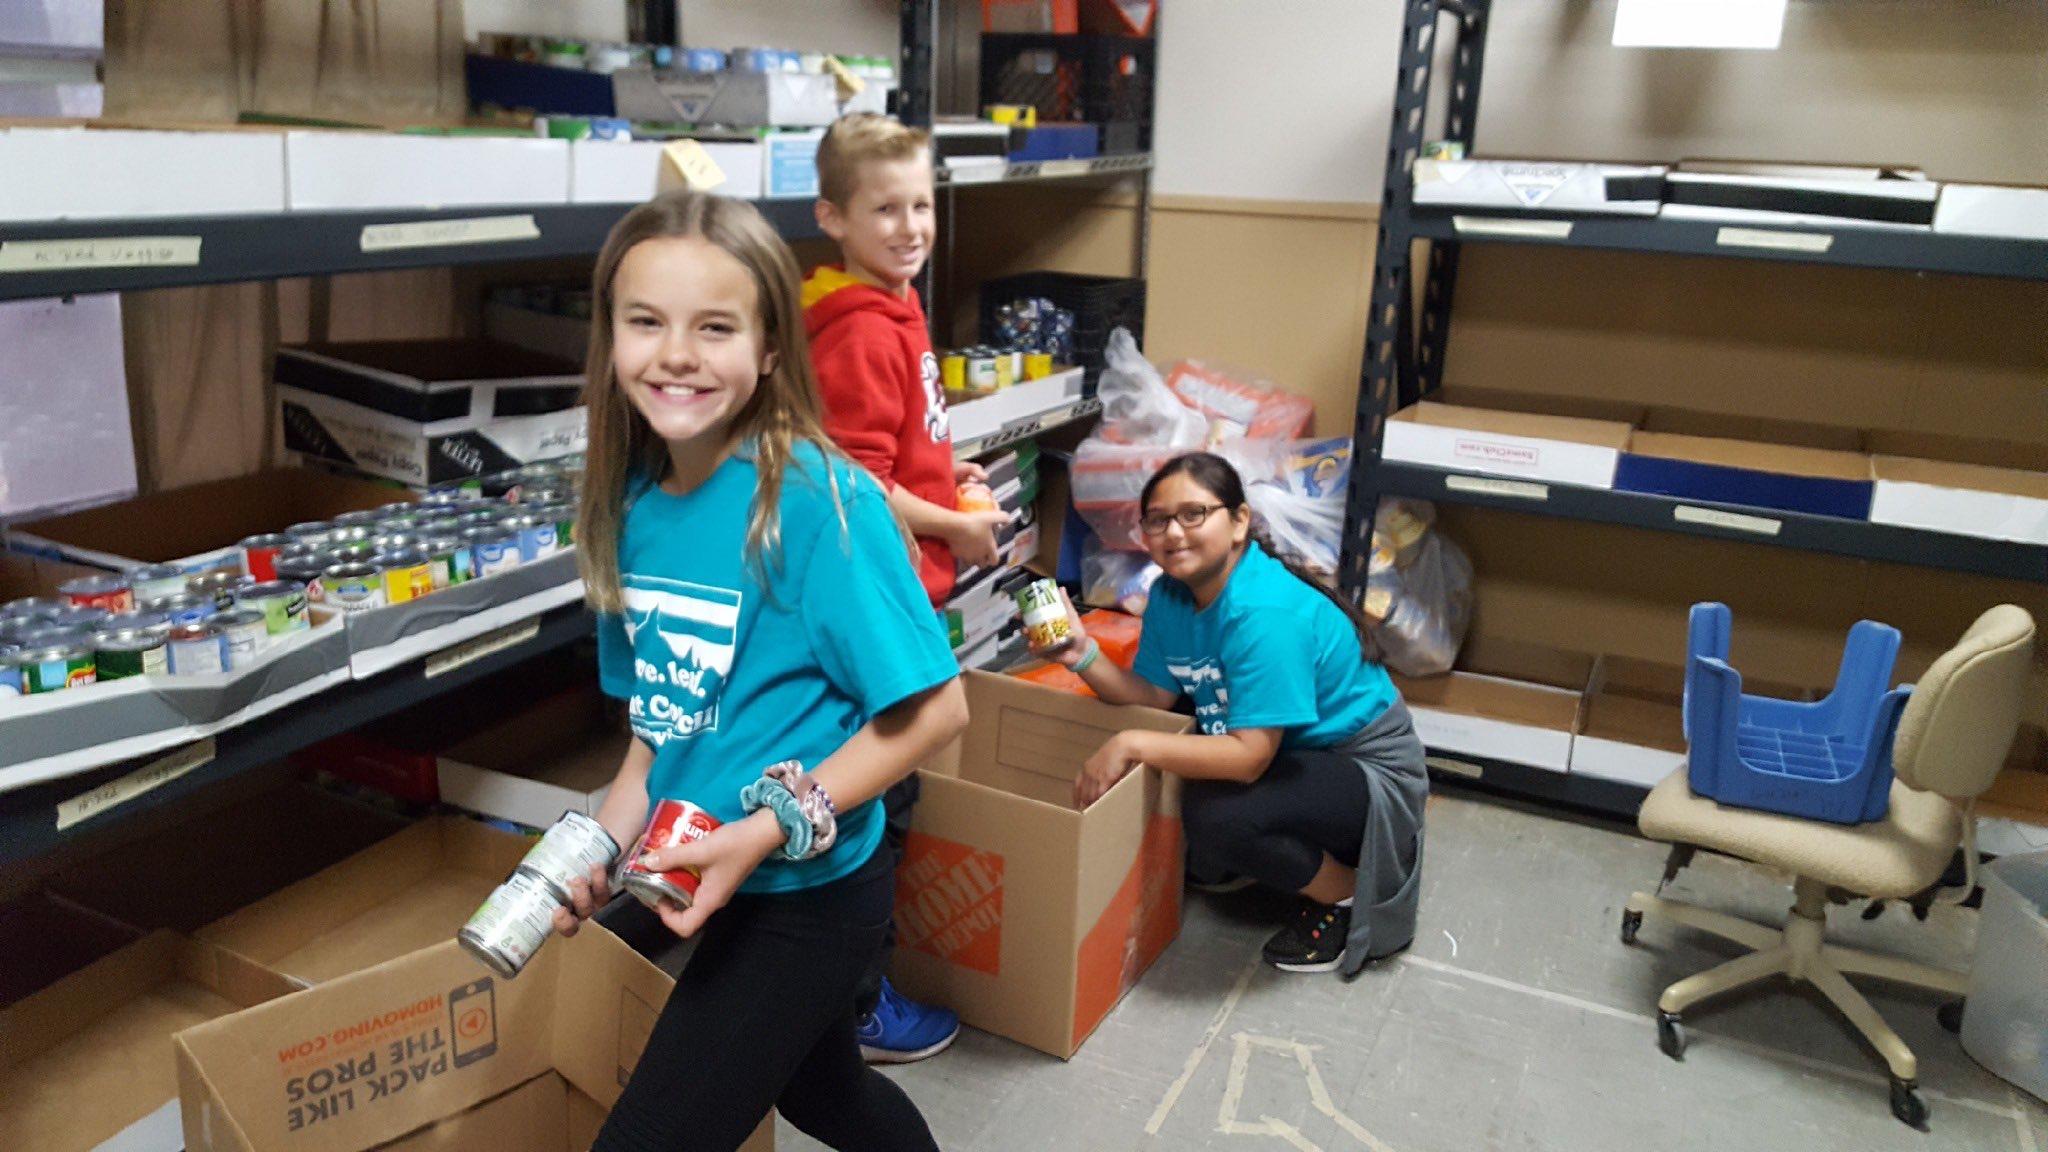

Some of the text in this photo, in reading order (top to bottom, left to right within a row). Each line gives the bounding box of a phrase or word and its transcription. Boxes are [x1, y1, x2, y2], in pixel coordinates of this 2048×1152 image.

[894, 847, 1004, 943] HOME
[932, 898, 1002, 959] DEPOT
[277, 993, 443, 1063] HDMOVING.COM
[389, 1026, 447, 1066] THE
[286, 1051, 377, 1103] PROS
[287, 1051, 448, 1132] PACK LIKE
